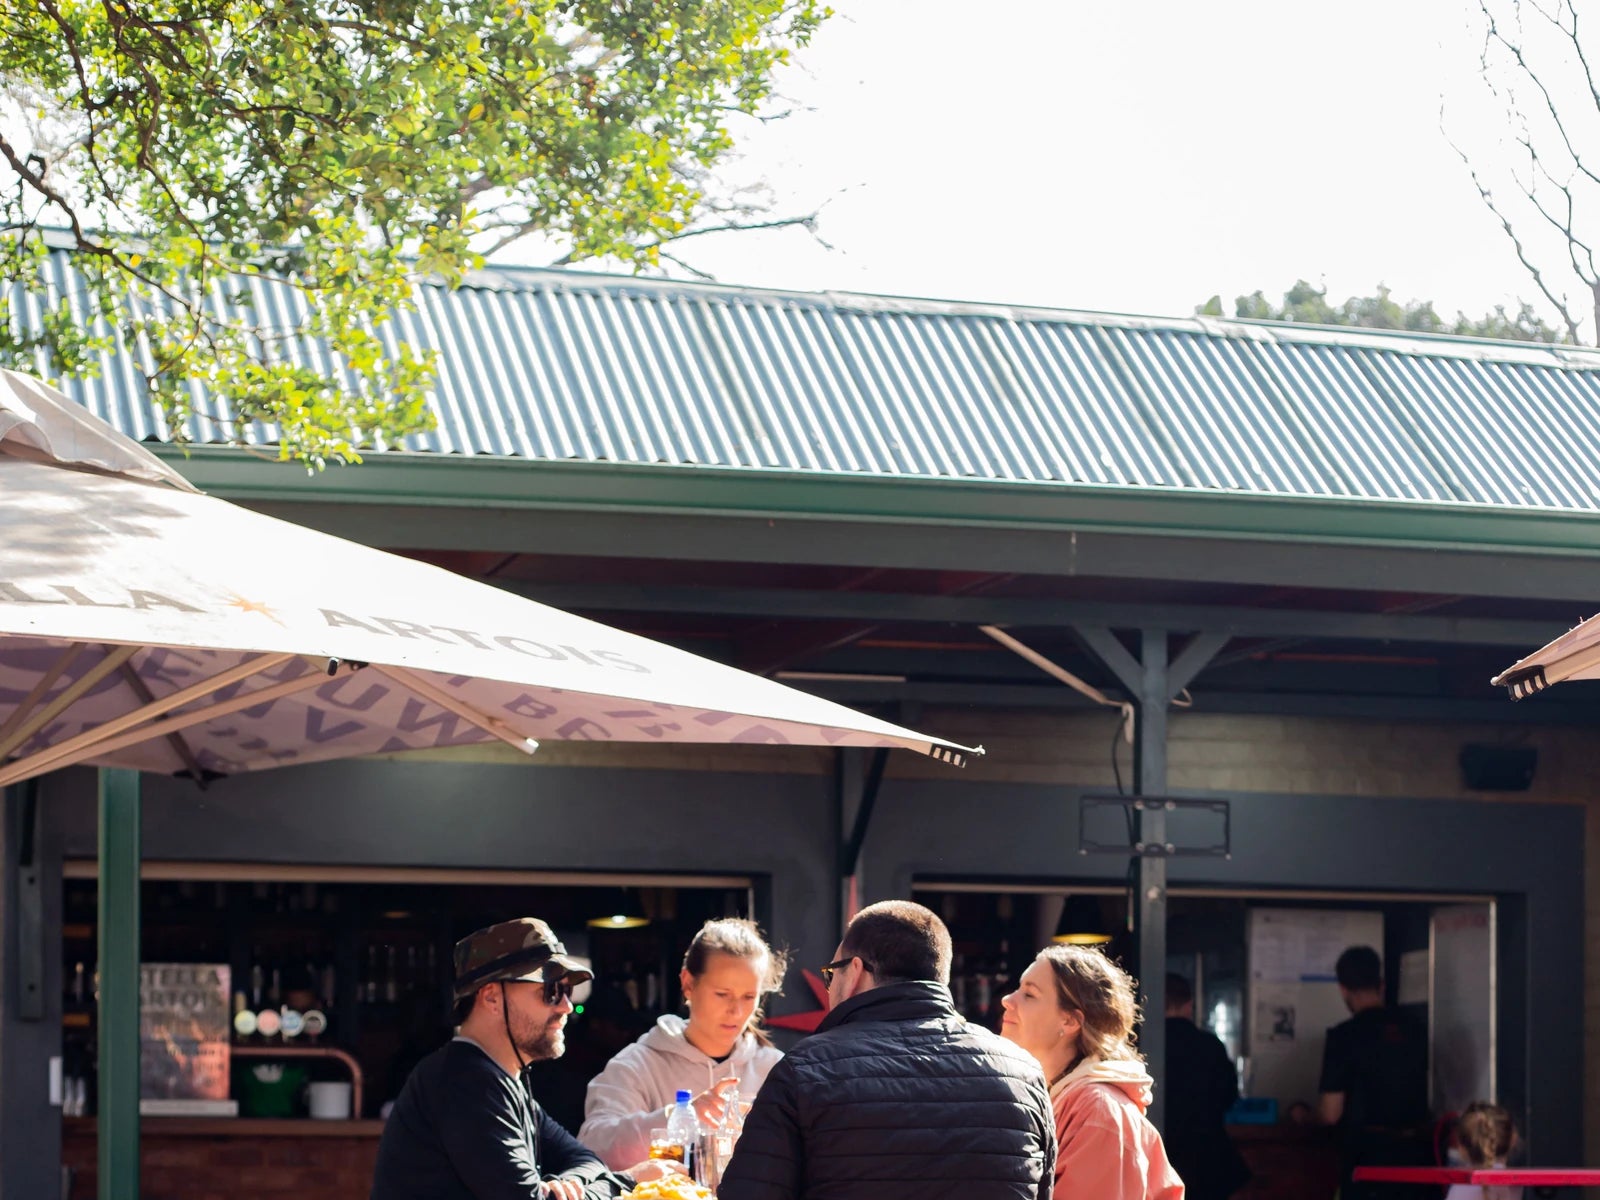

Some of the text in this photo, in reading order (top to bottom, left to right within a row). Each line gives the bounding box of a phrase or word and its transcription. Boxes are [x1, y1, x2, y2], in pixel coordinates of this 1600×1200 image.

[0, 582, 652, 674] LLA ARTOIS
[141, 967, 222, 987] TELLA
